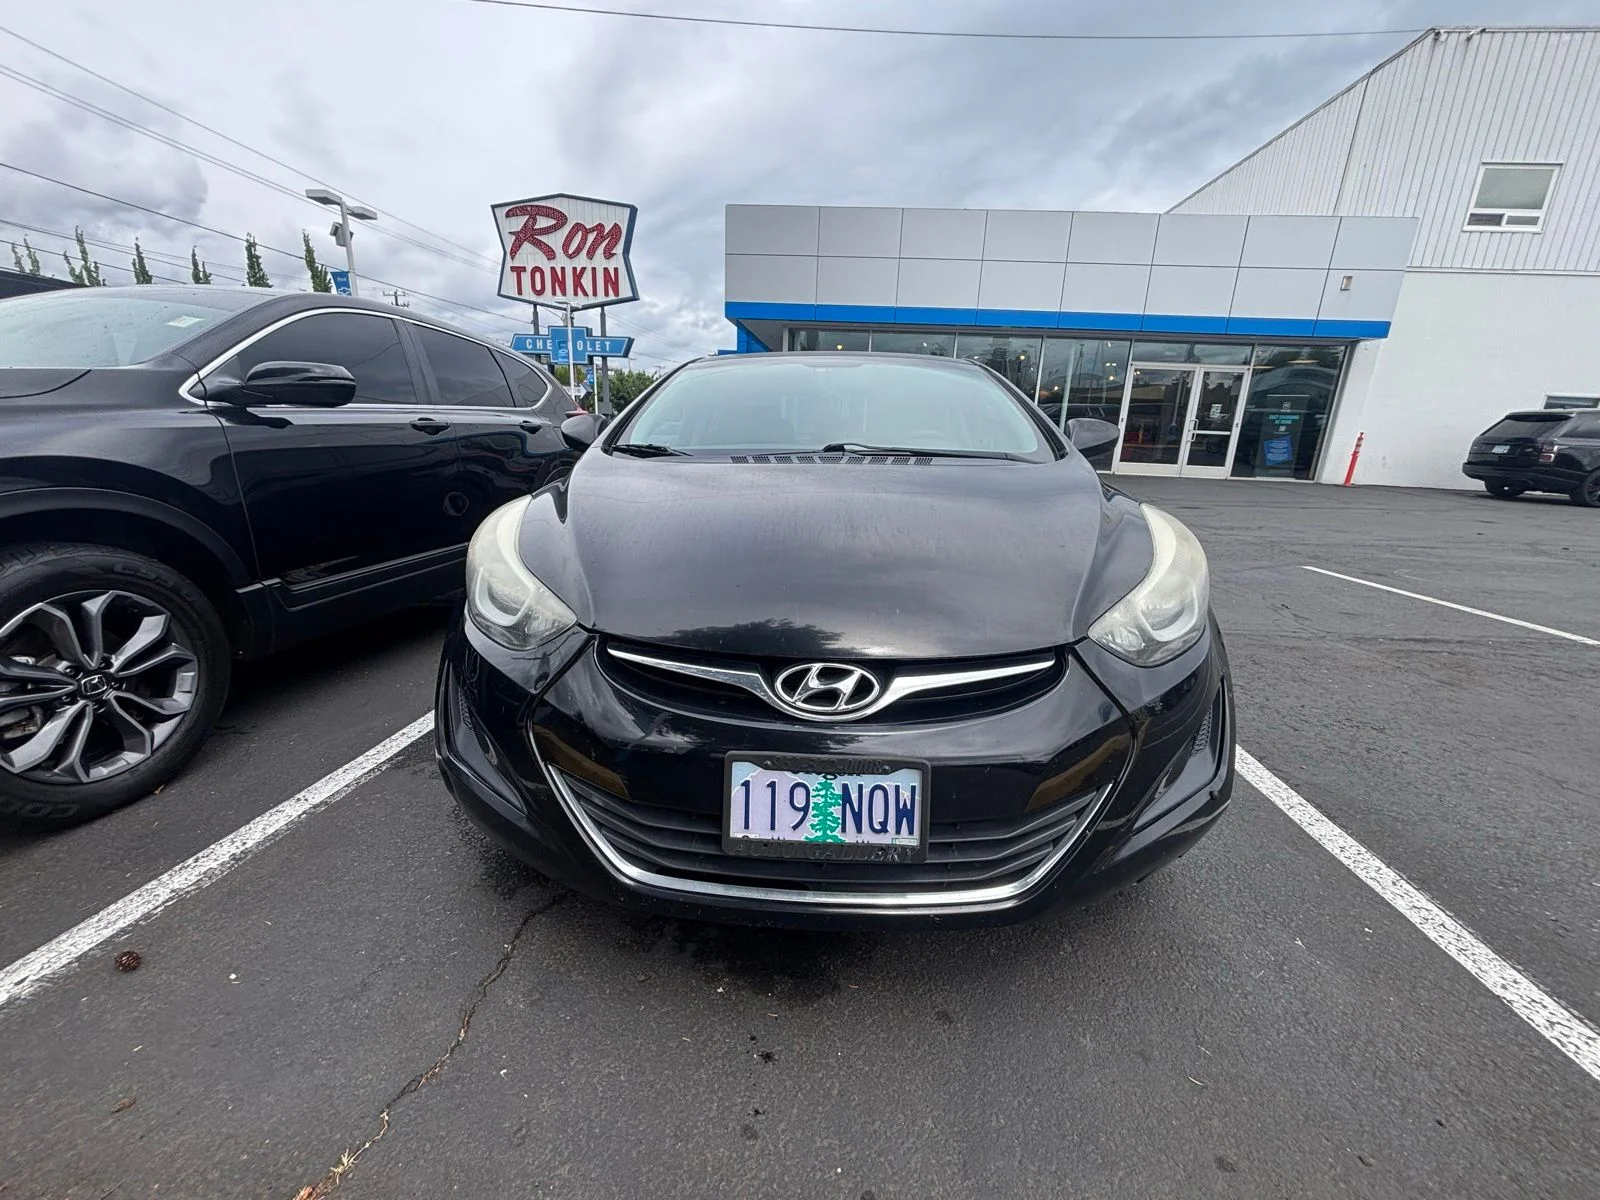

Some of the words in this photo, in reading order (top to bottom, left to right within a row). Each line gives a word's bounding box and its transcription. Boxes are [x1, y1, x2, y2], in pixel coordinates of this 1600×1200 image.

[505, 204, 622, 261] Ron
[510, 266, 620, 297] TONKIN
[526, 338, 611, 352] CHEOLET
[741, 780, 811, 831] 119
[841, 783, 917, 835] NQW
